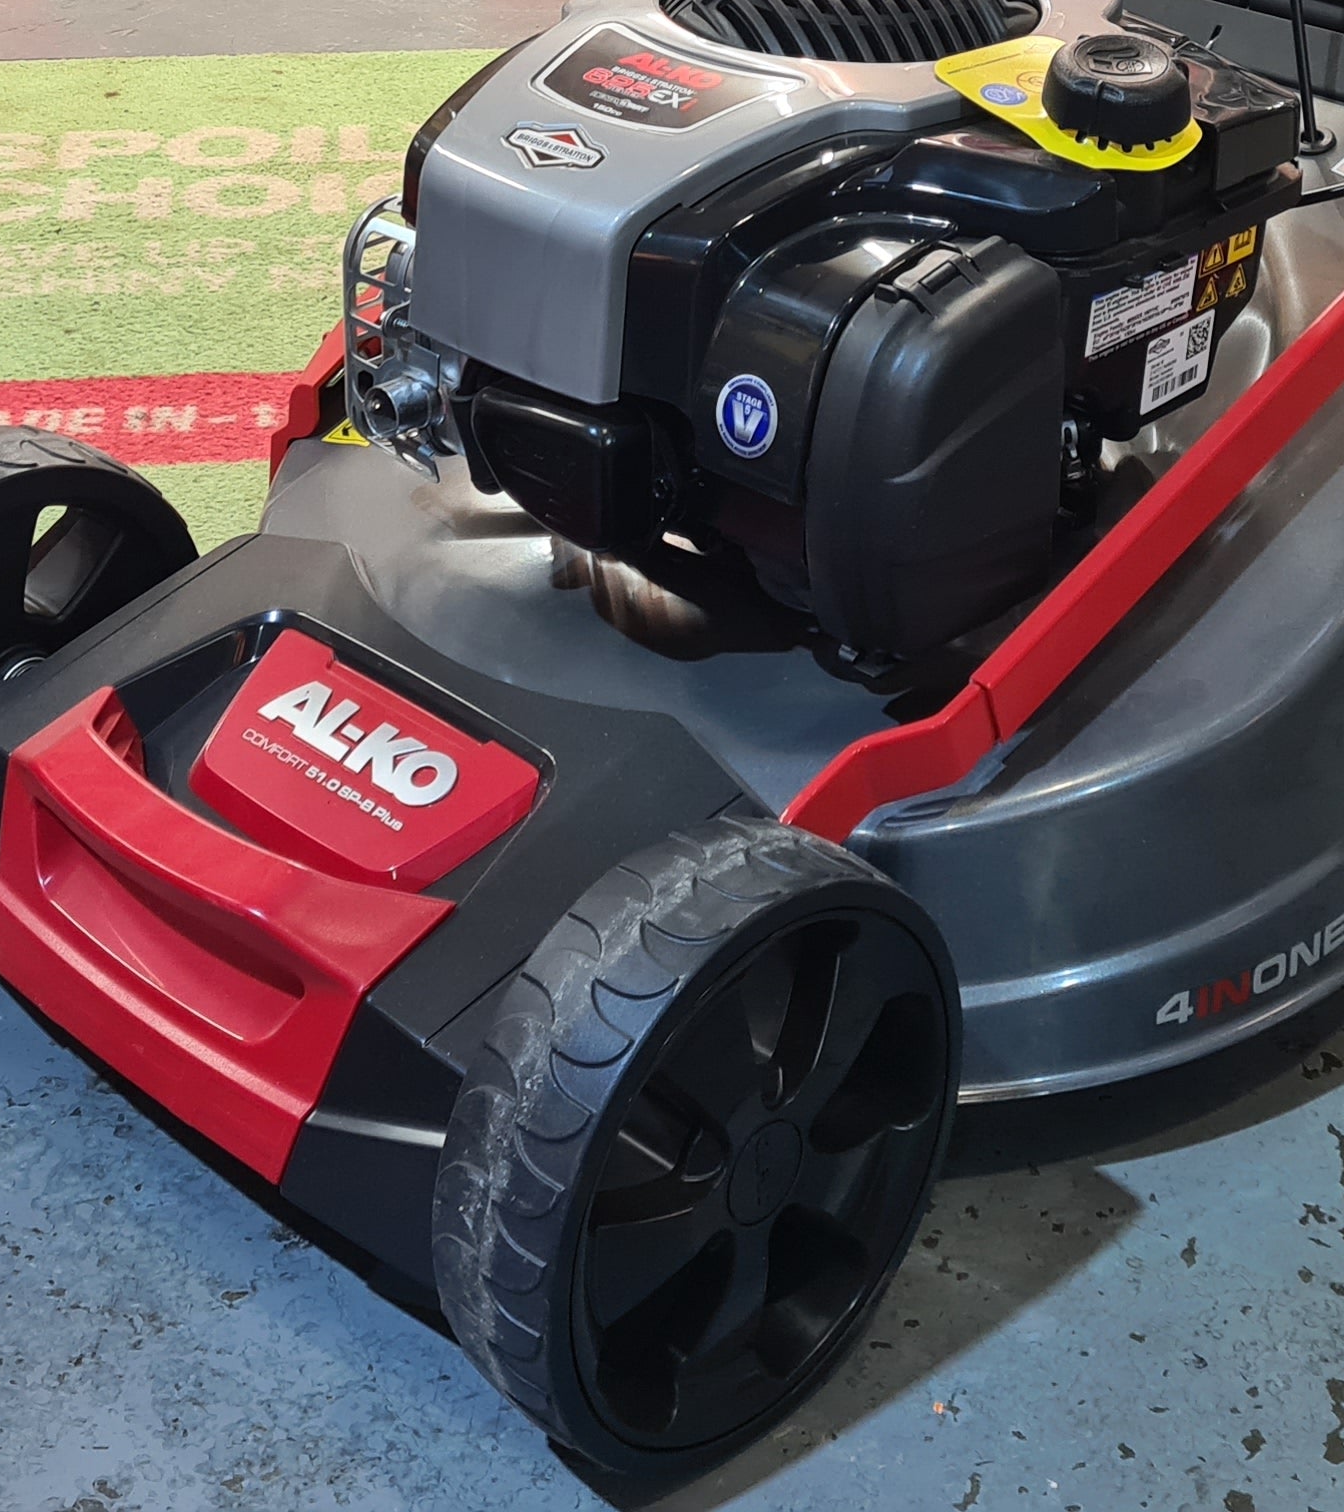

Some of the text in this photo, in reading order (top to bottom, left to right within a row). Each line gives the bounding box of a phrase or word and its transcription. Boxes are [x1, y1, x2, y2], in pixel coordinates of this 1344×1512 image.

[618, 52, 724, 89] AL-KO
[732, 398, 765, 444] V
[736, 391, 763, 409] STAGE
[256, 680, 459, 807] AL-KO
[242, 728, 404, 832] COMFORT 51.0 SP-B Plus
